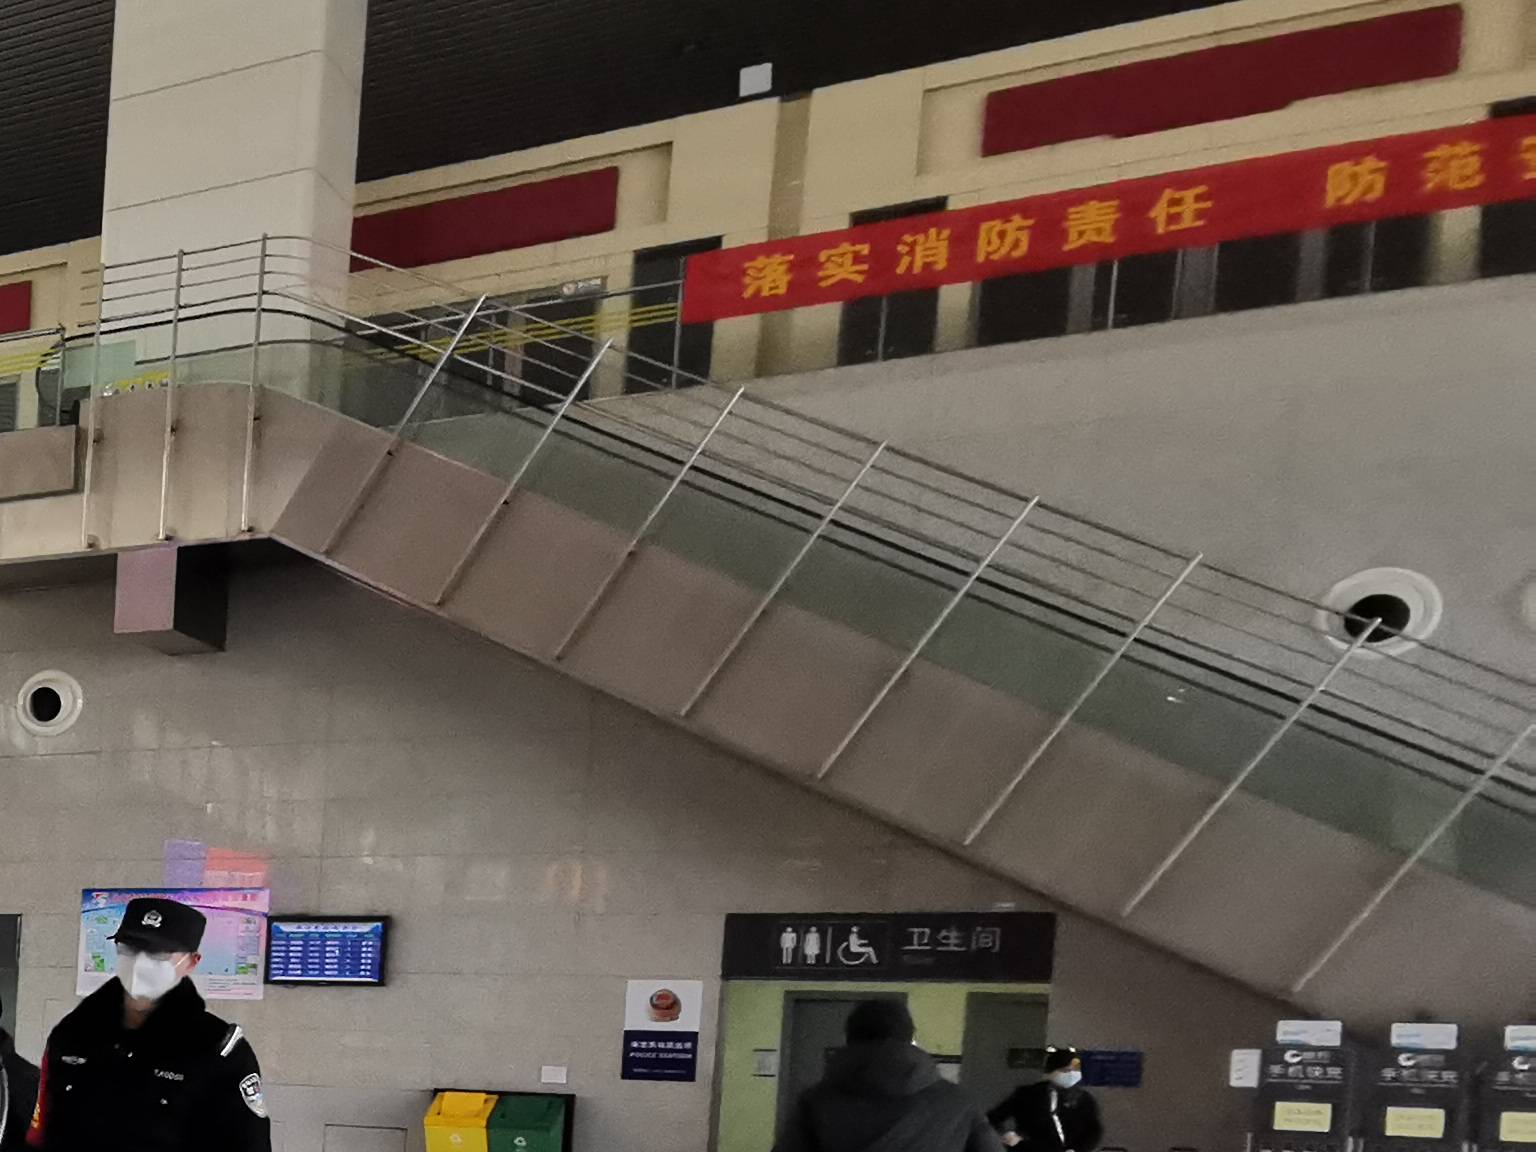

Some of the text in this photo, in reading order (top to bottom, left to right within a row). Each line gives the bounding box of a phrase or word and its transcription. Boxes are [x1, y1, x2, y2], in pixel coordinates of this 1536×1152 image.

[743, 185, 1213, 298] 落实消防责任
[900, 926, 1002, 953] 卫生间
